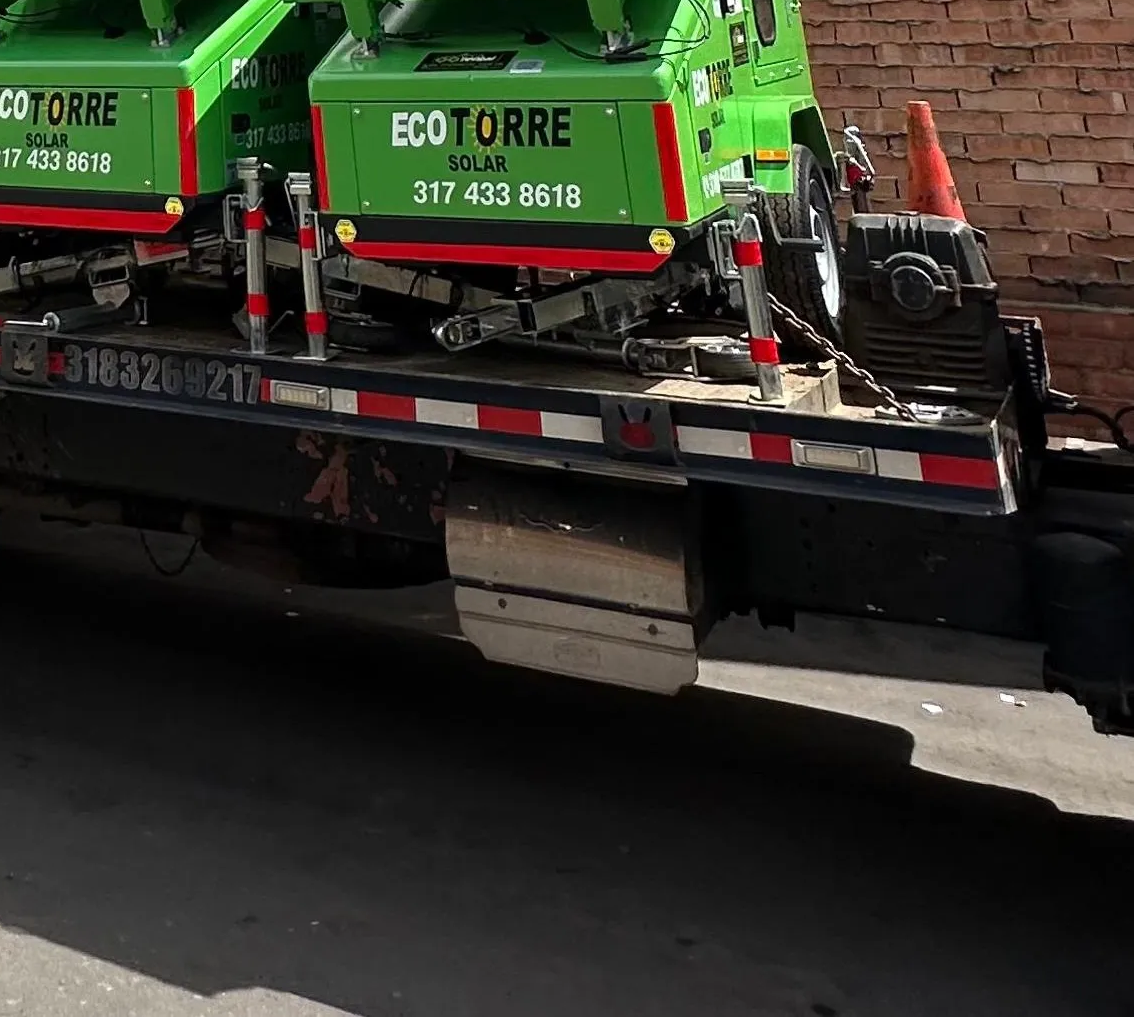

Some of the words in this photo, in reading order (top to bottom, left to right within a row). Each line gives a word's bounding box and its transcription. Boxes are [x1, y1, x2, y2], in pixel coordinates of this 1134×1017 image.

[25, 132, 69, 148] SOLAR
[245, 126, 265, 149] 317
[267, 123, 286, 145] 433
[391, 106, 572, 148] ECOTORRE
[26, 148, 61, 171] 433
[65, 150, 112, 174] 8618
[448, 153, 509, 173] SOLAR
[413, 180, 456, 205] 317
[463, 181, 511, 207] 433
[518, 182, 582, 209] 8618
[64, 343, 262, 405] 3183269217
